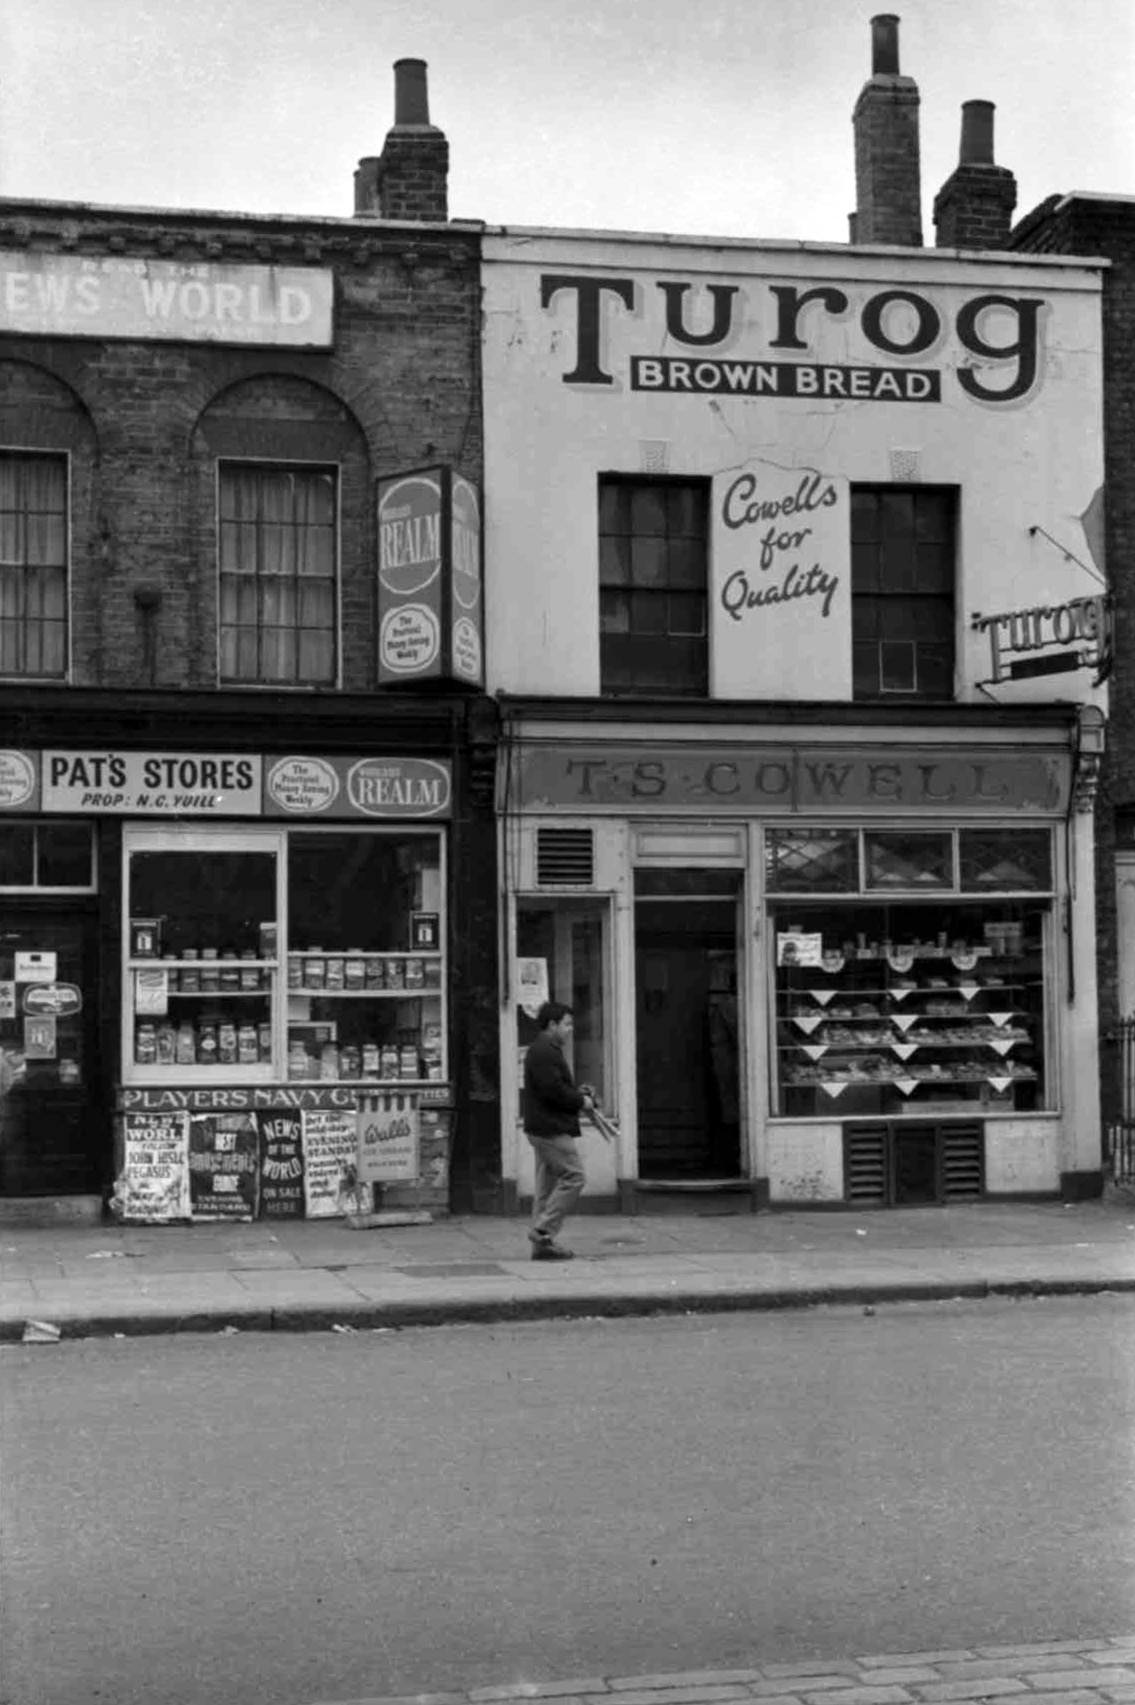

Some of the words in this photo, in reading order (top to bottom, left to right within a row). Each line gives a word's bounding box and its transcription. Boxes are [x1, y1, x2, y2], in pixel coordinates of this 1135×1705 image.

[139, 281, 312, 325] WORLD
[540, 274, 1045, 402] Turog
[637, 360, 779, 392] BROWN
[796, 367, 932, 399] BREAD
[722, 473, 837, 530] Cowells
[760, 526, 813, 571] for
[721, 562, 839, 622] Quality
[51, 753, 127, 788] PAT'S
[143, 758, 253, 790] STORES
[704, 761, 1009, 800] COWELL
[358, 777, 442, 806] REALM
[253, 1088, 325, 1107] NAVY
[128, 1129, 183, 1141] WORL
[263, 1119, 301, 1141] NEWS
[262, 1156, 302, 1179] WORLD
